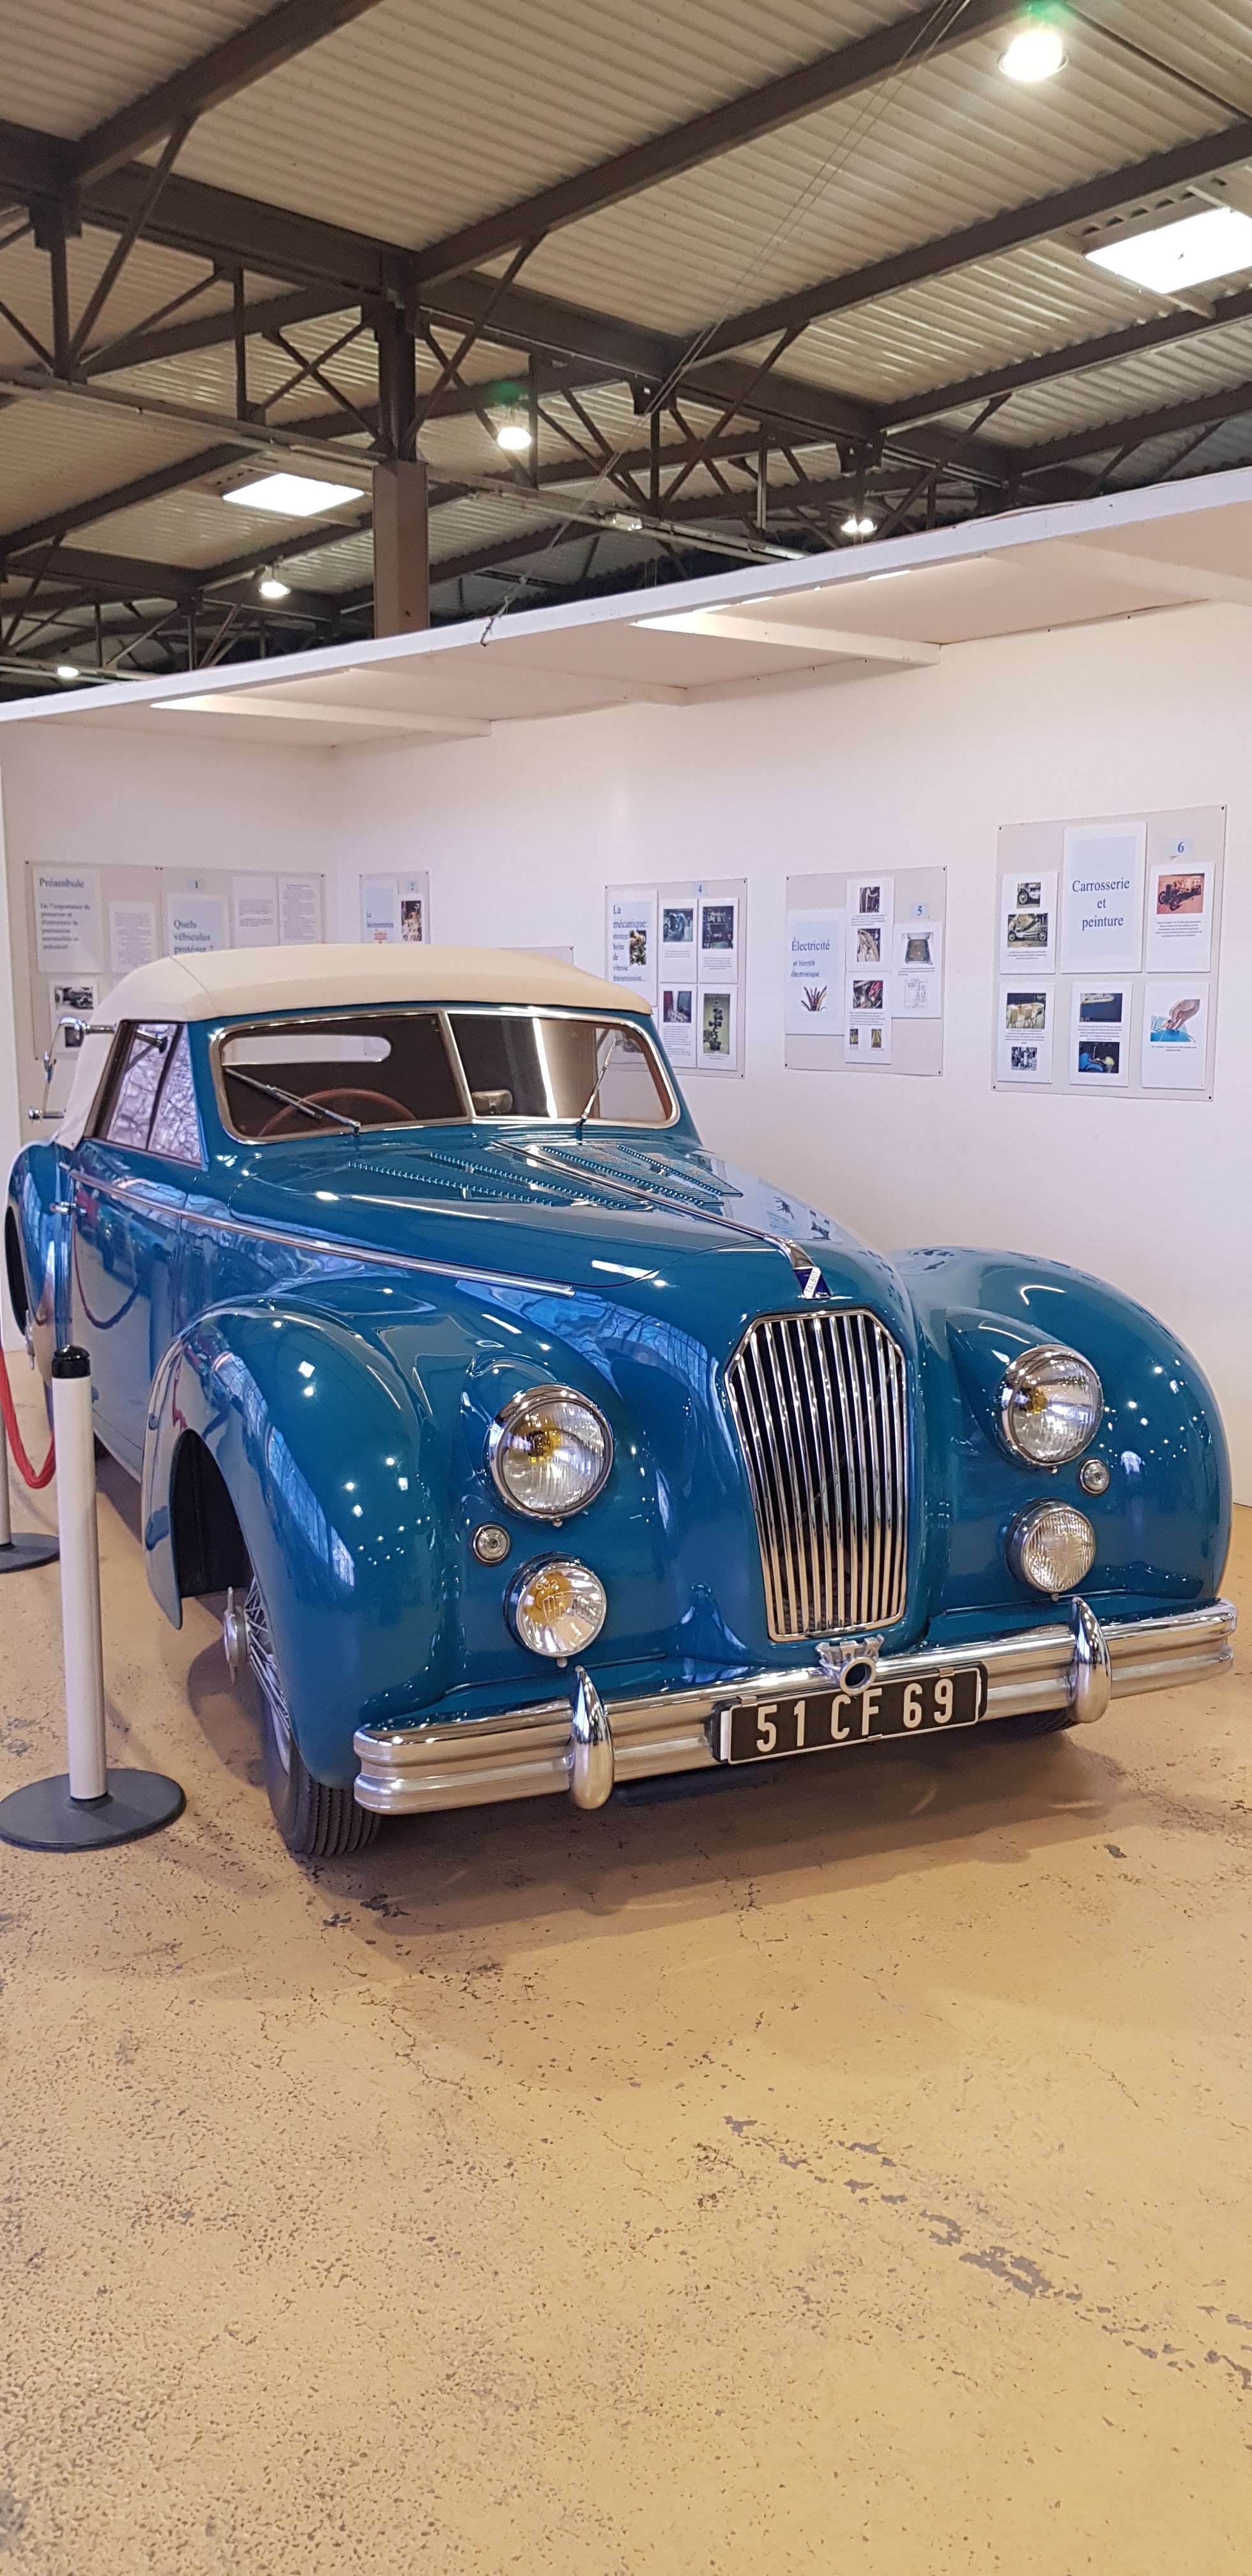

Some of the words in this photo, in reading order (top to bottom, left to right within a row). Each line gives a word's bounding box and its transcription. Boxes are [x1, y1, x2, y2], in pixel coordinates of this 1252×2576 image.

[1178, 841, 1184, 853] 6
[698, 884, 702, 894] 4
[1072, 877, 1130, 893] Carrosserie
[1097, 898, 1106, 908] et
[613, 905, 621, 914] La
[917, 905, 922, 916] 5
[174, 920, 197, 930] Quels
[1082, 915, 1124, 931] peinture
[791, 938, 830, 951] Électricité
[805, 1271, 819, 1293] TALBOT
[535, 1579, 558, 1590] 632
[756, 1699, 805, 1752] 51
[830, 1688, 882, 1740] CF
[903, 1678, 954, 1728] 69
